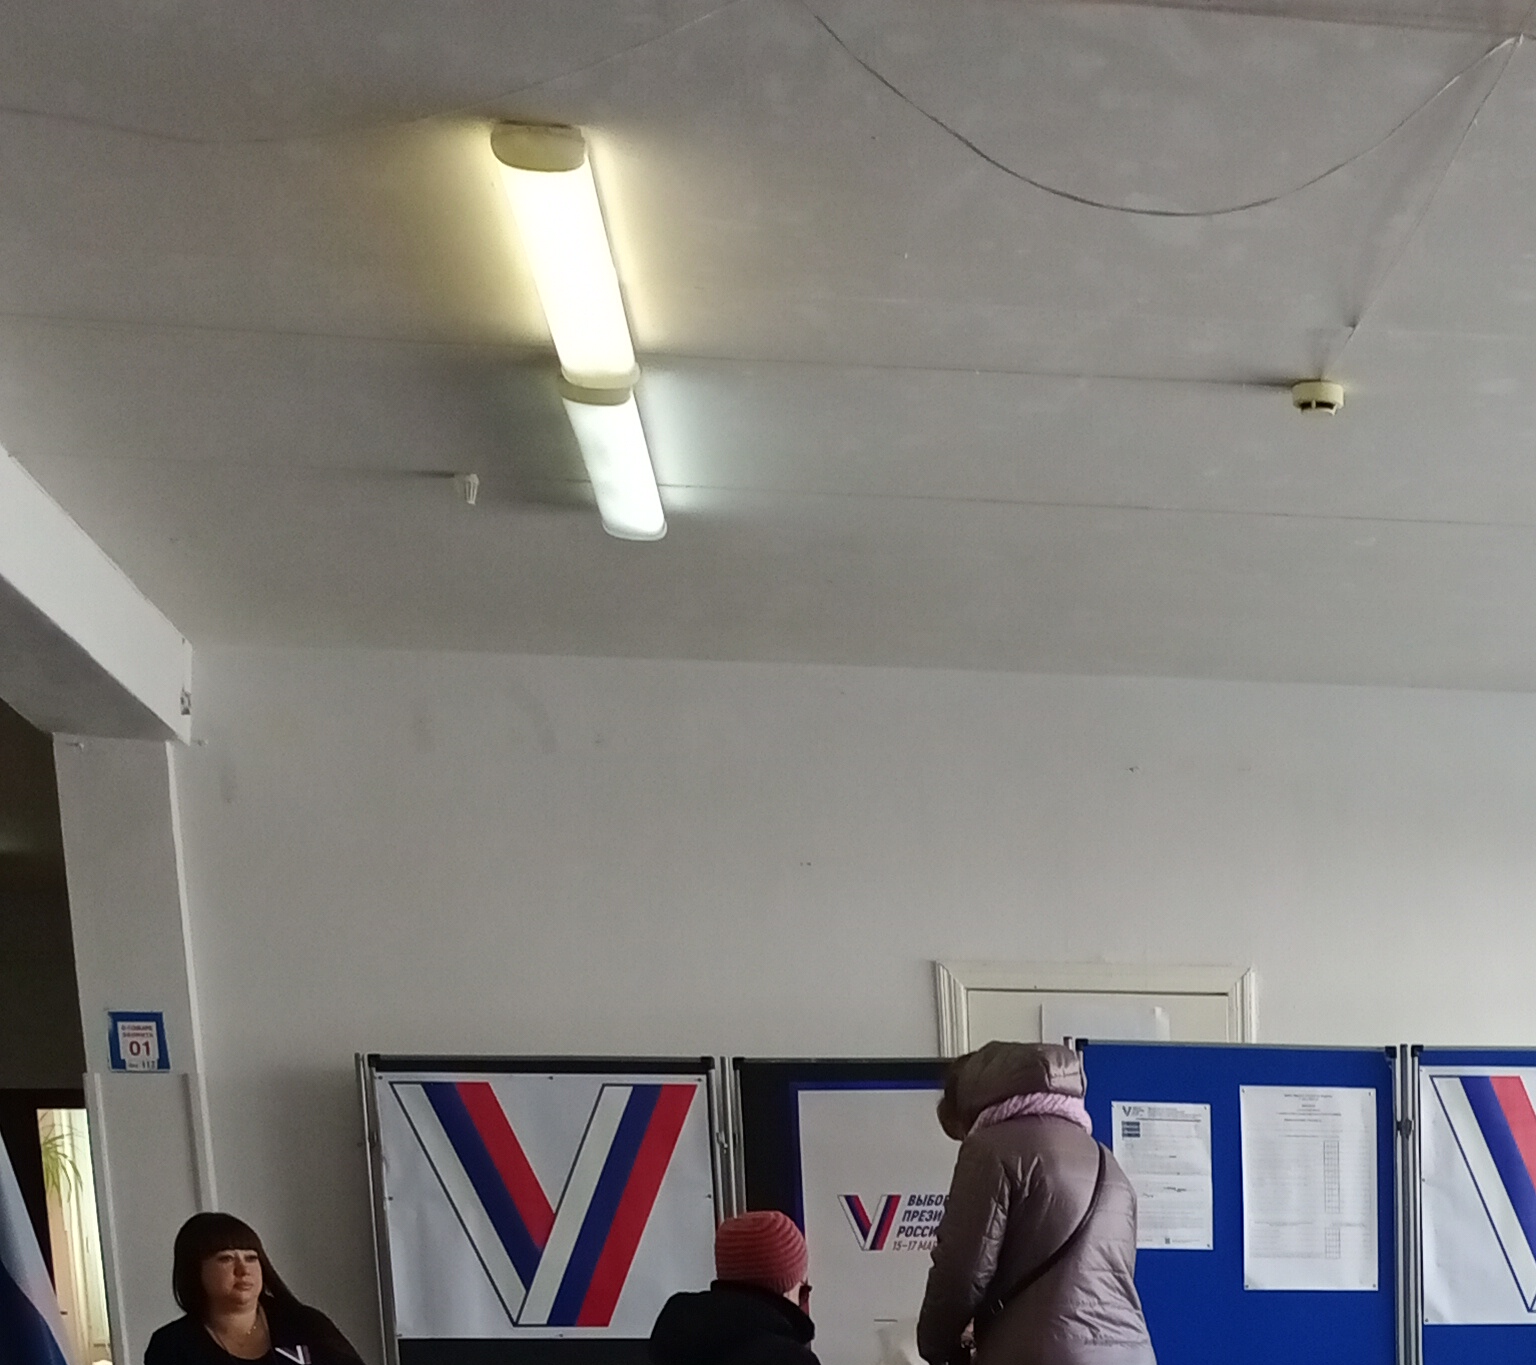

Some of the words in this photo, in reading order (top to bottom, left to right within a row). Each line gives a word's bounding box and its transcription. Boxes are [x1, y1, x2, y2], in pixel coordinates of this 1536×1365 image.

[129, 1041, 150, 1056] 01
[907, 1195, 949, 1206] ВЫБОР
[902, 1210, 943, 1222] ПРЕЗИ
[896, 1226, 937, 1237] РОССИ
